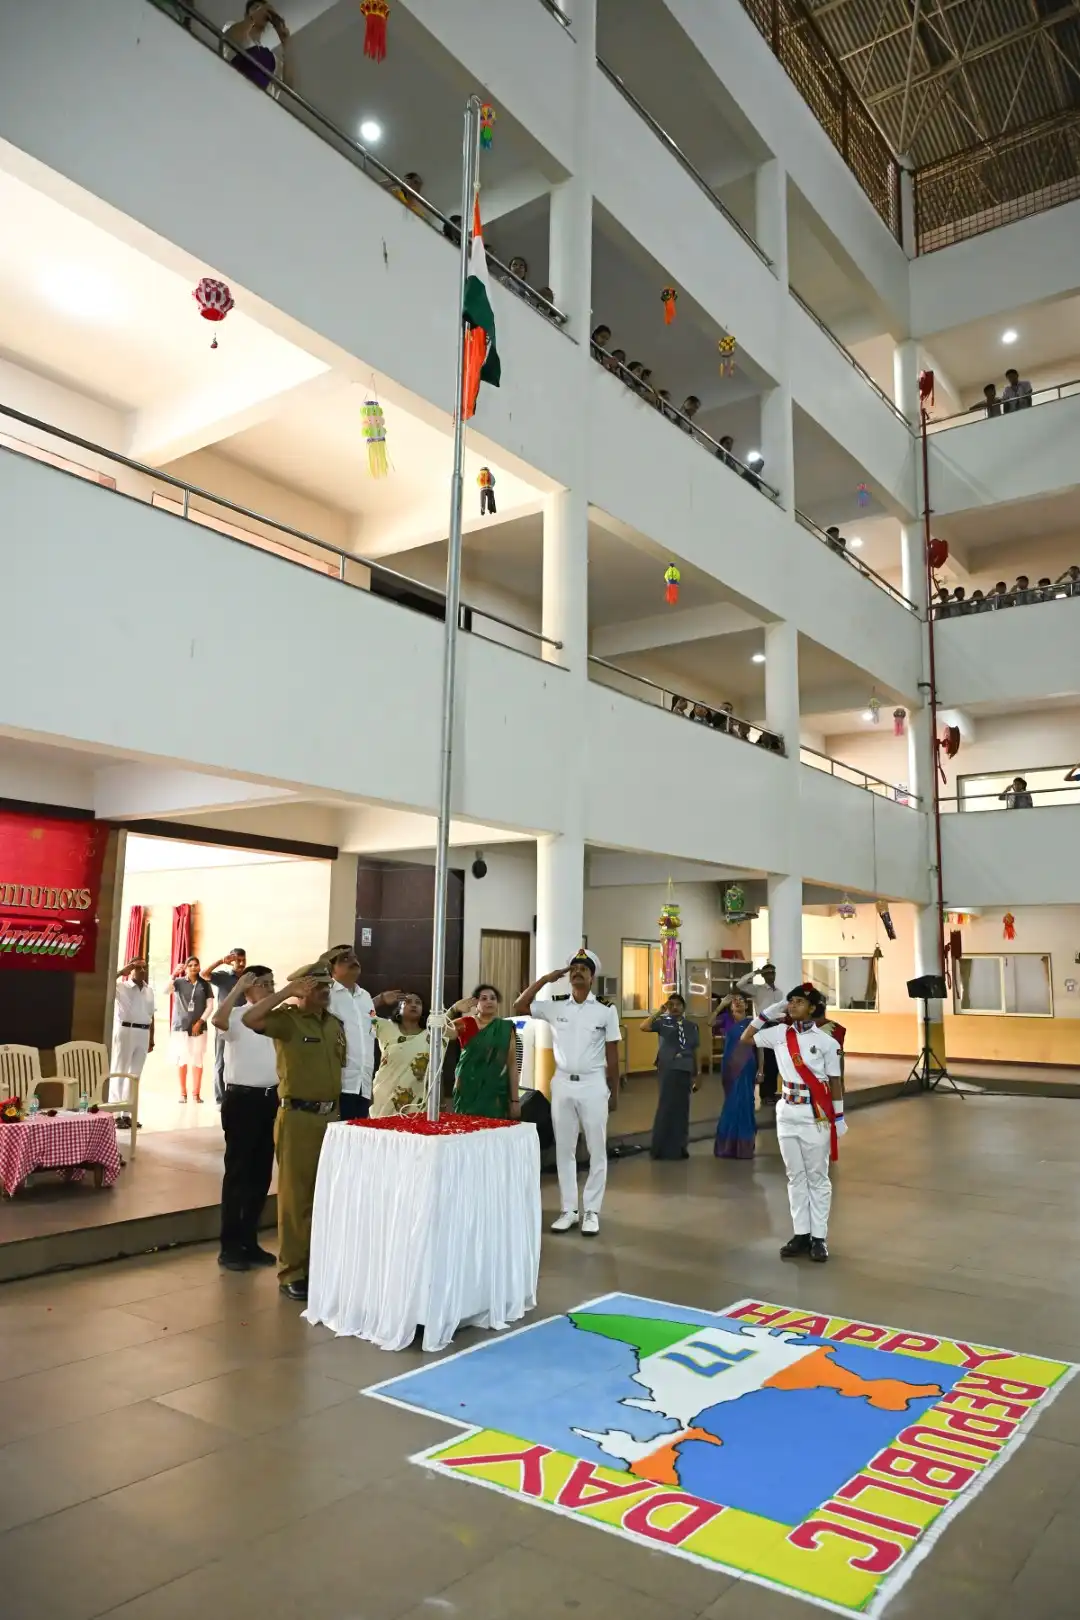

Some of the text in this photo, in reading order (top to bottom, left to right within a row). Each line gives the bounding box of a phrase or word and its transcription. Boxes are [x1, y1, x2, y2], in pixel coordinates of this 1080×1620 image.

[0, 884, 92, 910] TITUTIONS
[724, 1302, 1018, 1370] HAPPY
[438, 1444, 729, 1546] DAY
[786, 1371, 1049, 1574] REPUBLIC
